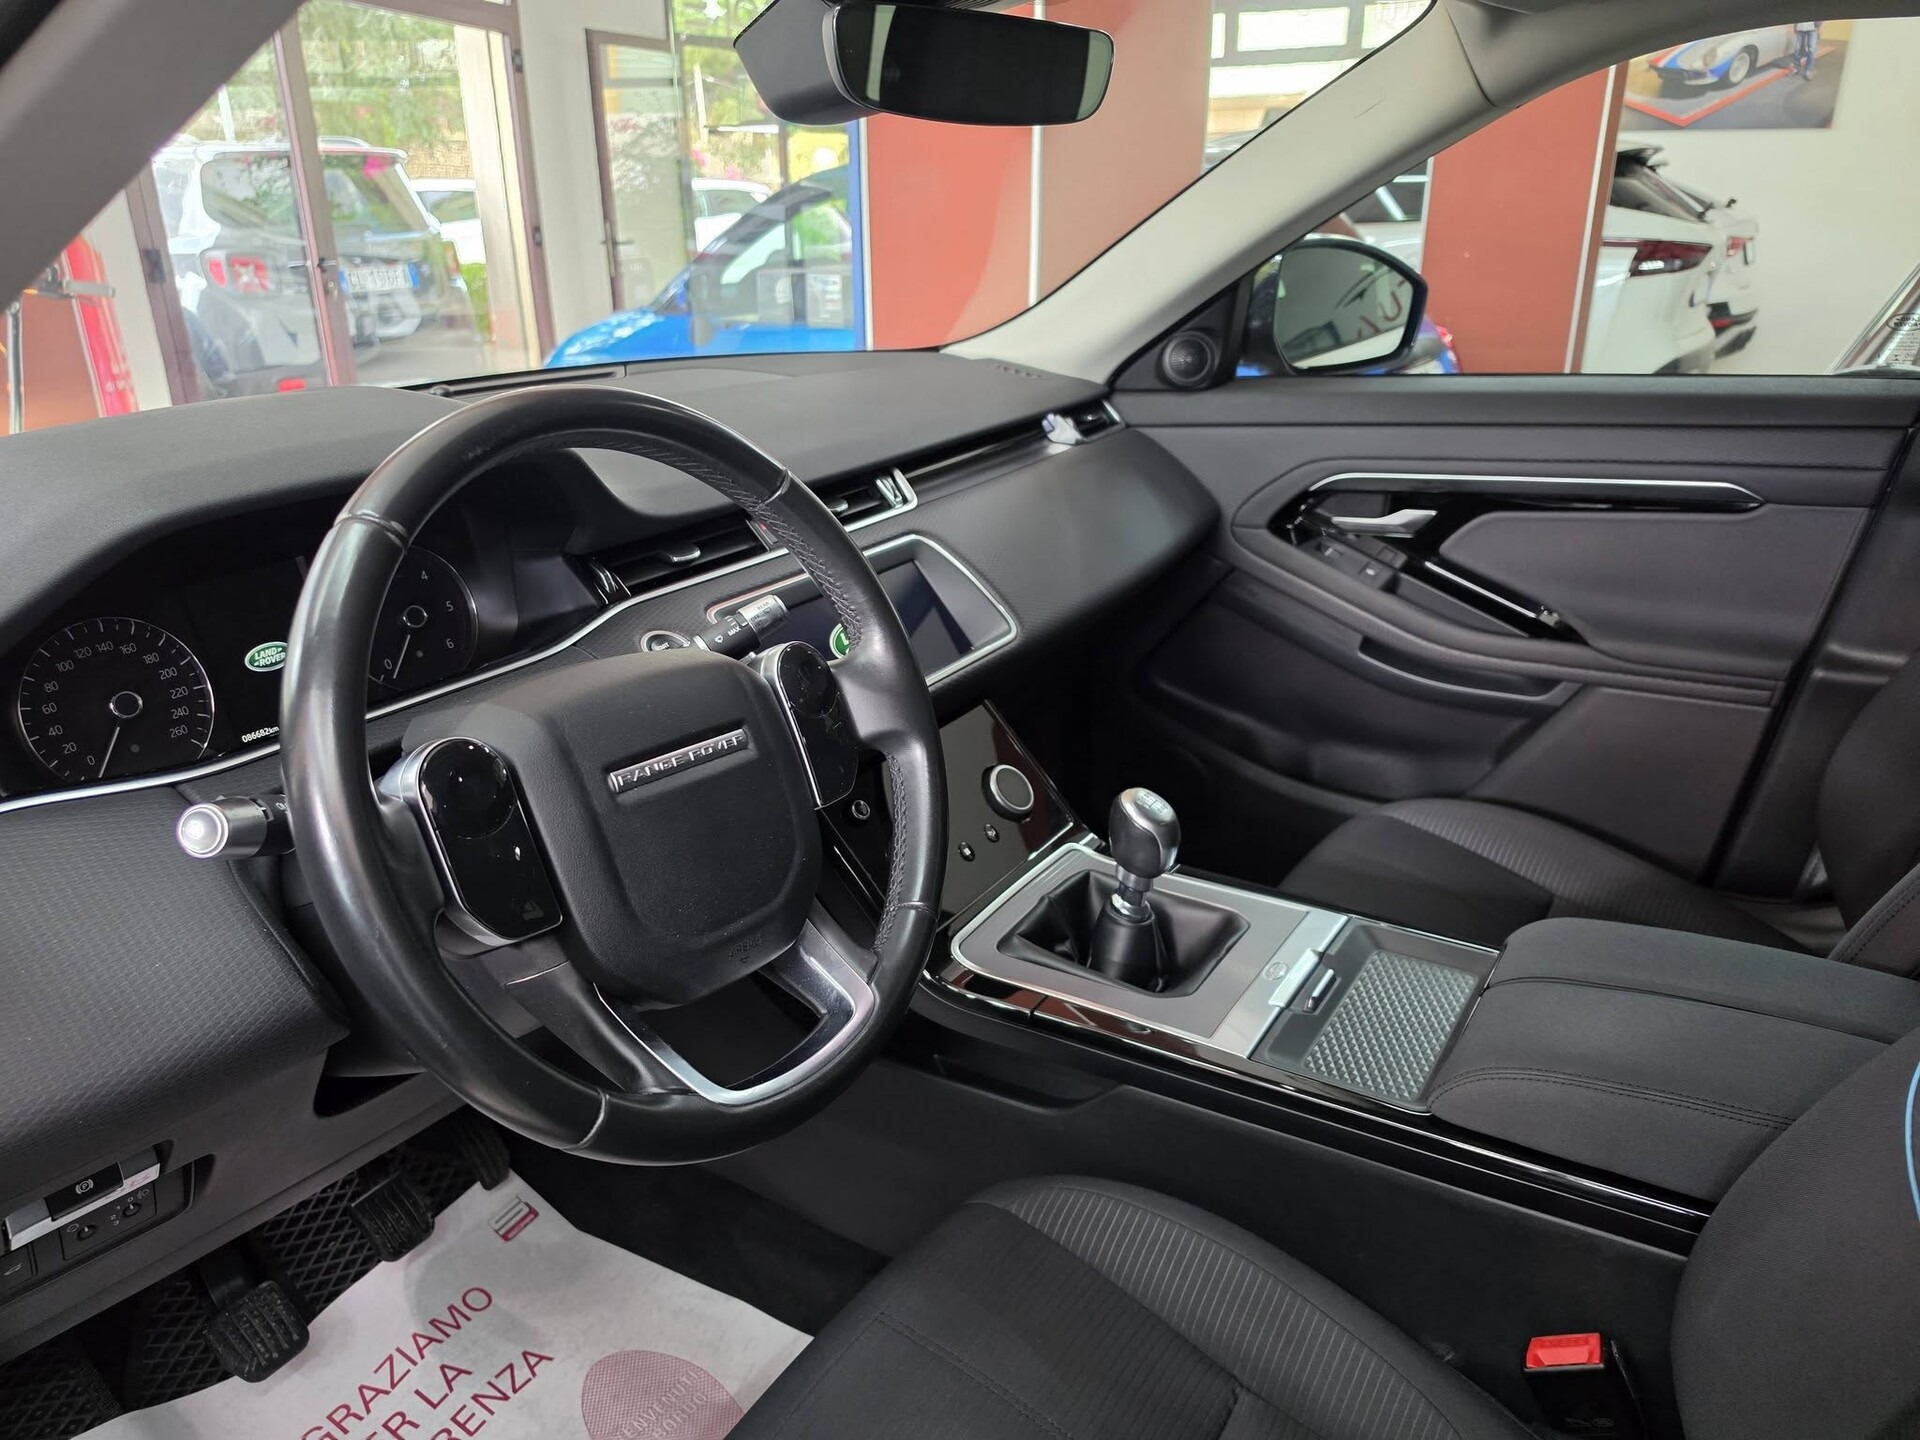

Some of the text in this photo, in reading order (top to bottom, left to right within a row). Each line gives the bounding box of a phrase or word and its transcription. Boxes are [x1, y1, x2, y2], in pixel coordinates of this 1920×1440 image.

[421, 570, 429, 580] 4
[446, 600, 454, 612] 5
[727, 625, 741, 637] MAX
[95, 641, 114, 653] 140
[119, 643, 137, 655] 160
[446, 638, 455, 649] 6
[74, 646, 92, 659] 120
[143, 652, 160, 664] 180
[254, 647, 277, 661] LAND
[56, 659, 74, 672] 100
[259, 652, 286, 667] ROVER
[384, 658, 393, 670] 0
[159, 667, 178, 680] 200
[44, 681, 59, 693] 80
[169, 686, 189, 699] 220
[42, 702, 58, 714] 60
[171, 706, 189, 719] 240
[48, 724, 63, 737] 40
[169, 725, 188, 738] 260
[62, 742, 77, 754] 20
[87, 755, 96, 765] 0
[617, 735, 745, 786] RANGE ROVER
[413, 1363, 473, 1410] LA
[619, 1370, 700, 1440] ENVENUTI
